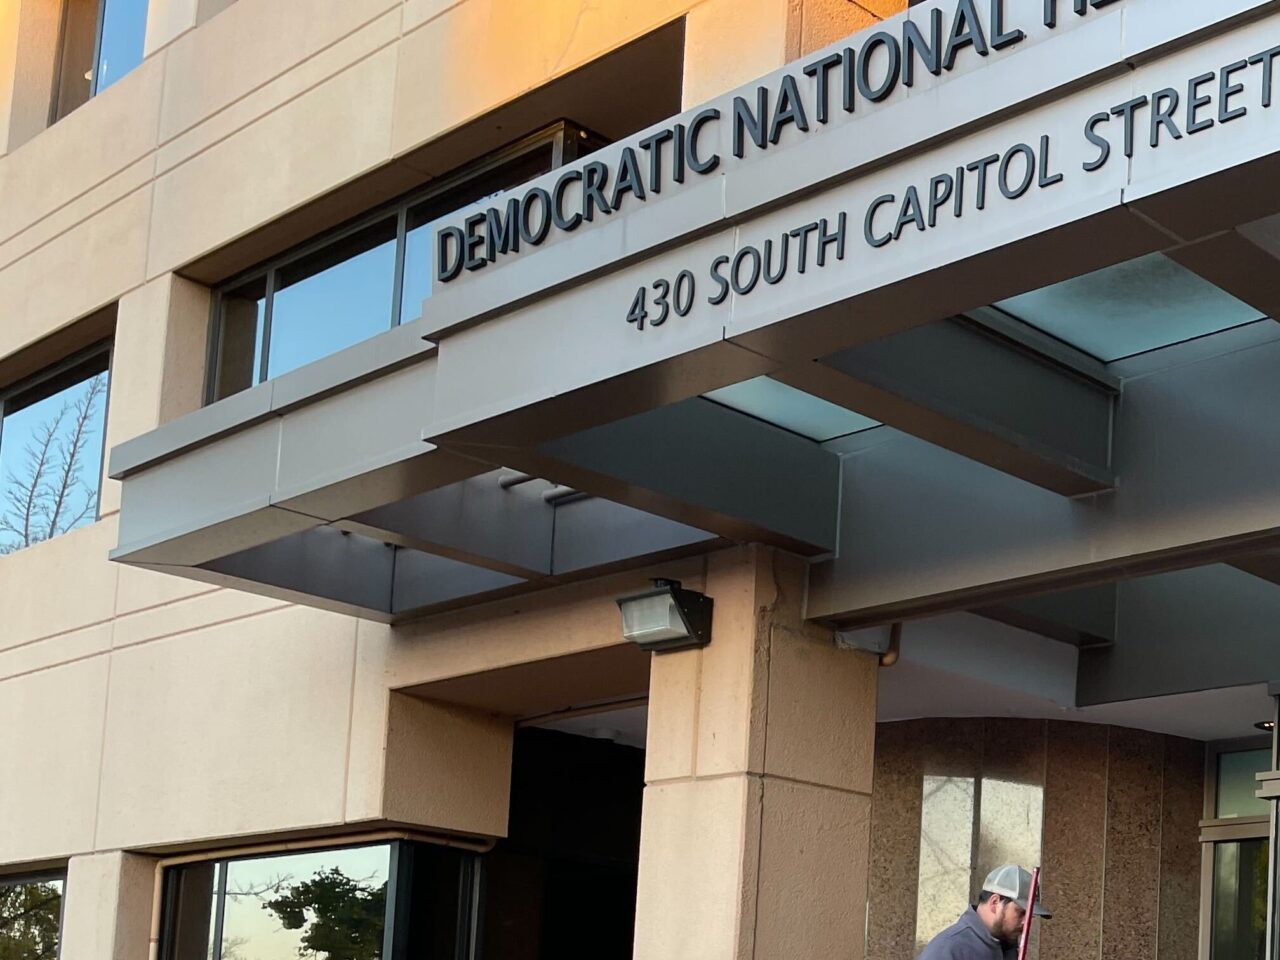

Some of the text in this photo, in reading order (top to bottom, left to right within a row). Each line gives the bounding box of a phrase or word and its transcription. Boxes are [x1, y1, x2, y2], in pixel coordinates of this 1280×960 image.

[437, 0, 1023, 282] DEMOCRATIC NATIONAL
[626, 269, 695, 331] 430
[708, 212, 847, 305] SOUTH
[864, 134, 1063, 248] CAPITOL
